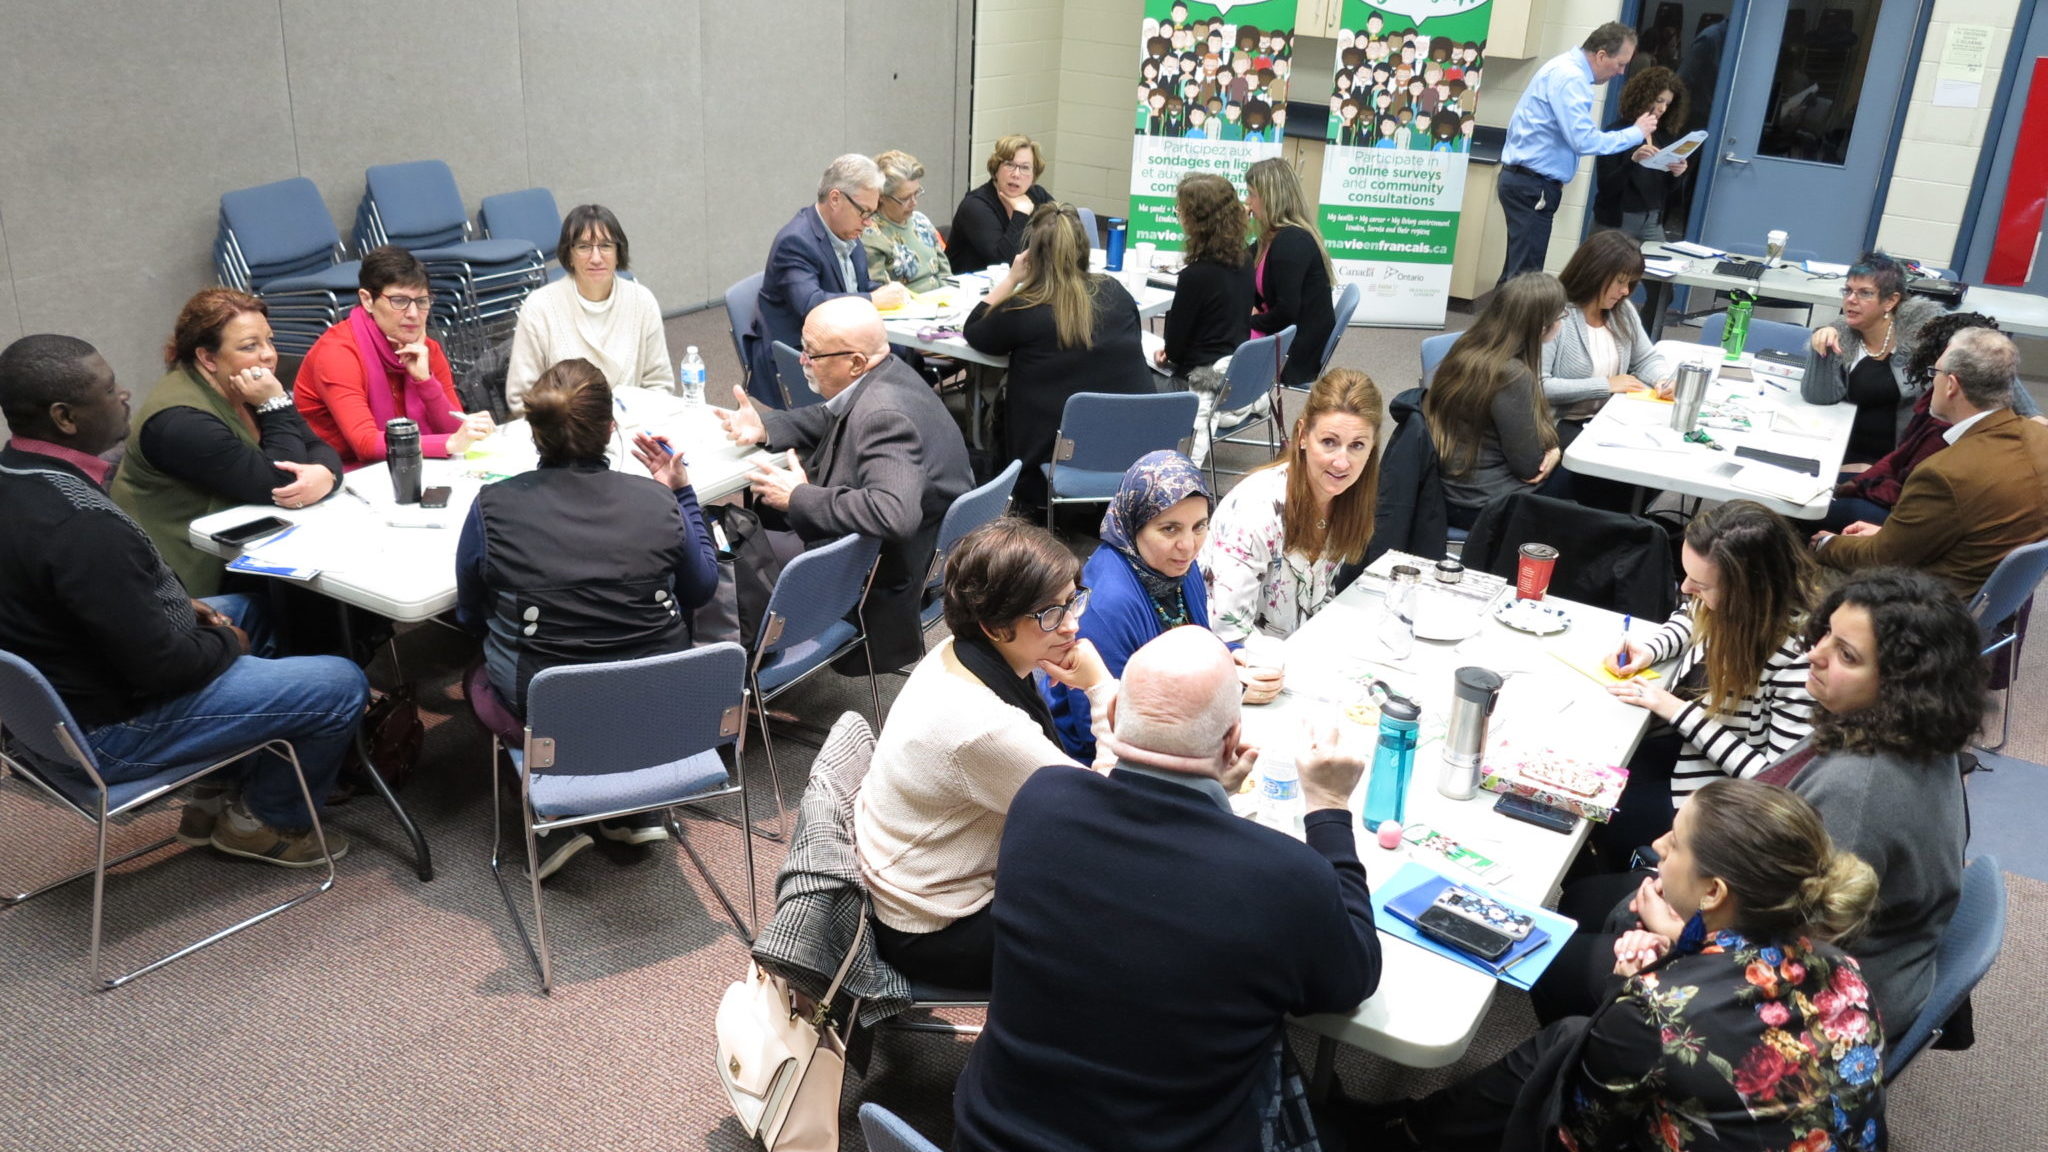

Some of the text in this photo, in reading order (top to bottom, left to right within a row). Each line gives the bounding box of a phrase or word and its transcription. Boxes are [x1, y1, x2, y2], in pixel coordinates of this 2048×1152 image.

[1164, 141, 1252, 156] Participez aux
[1148, 155, 1210, 169] sondages
[1214, 160, 1230, 169] en
[1355, 151, 1439, 166] Participate in
[1141, 169, 1179, 179] et aux
[1348, 165, 1441, 182] online surveys
[1342, 179, 1444, 196] and community
[1348, 192, 1435, 206] consultations
[1338, 264, 1374, 278] Canada
[1397, 272, 1424, 281] Ontario
